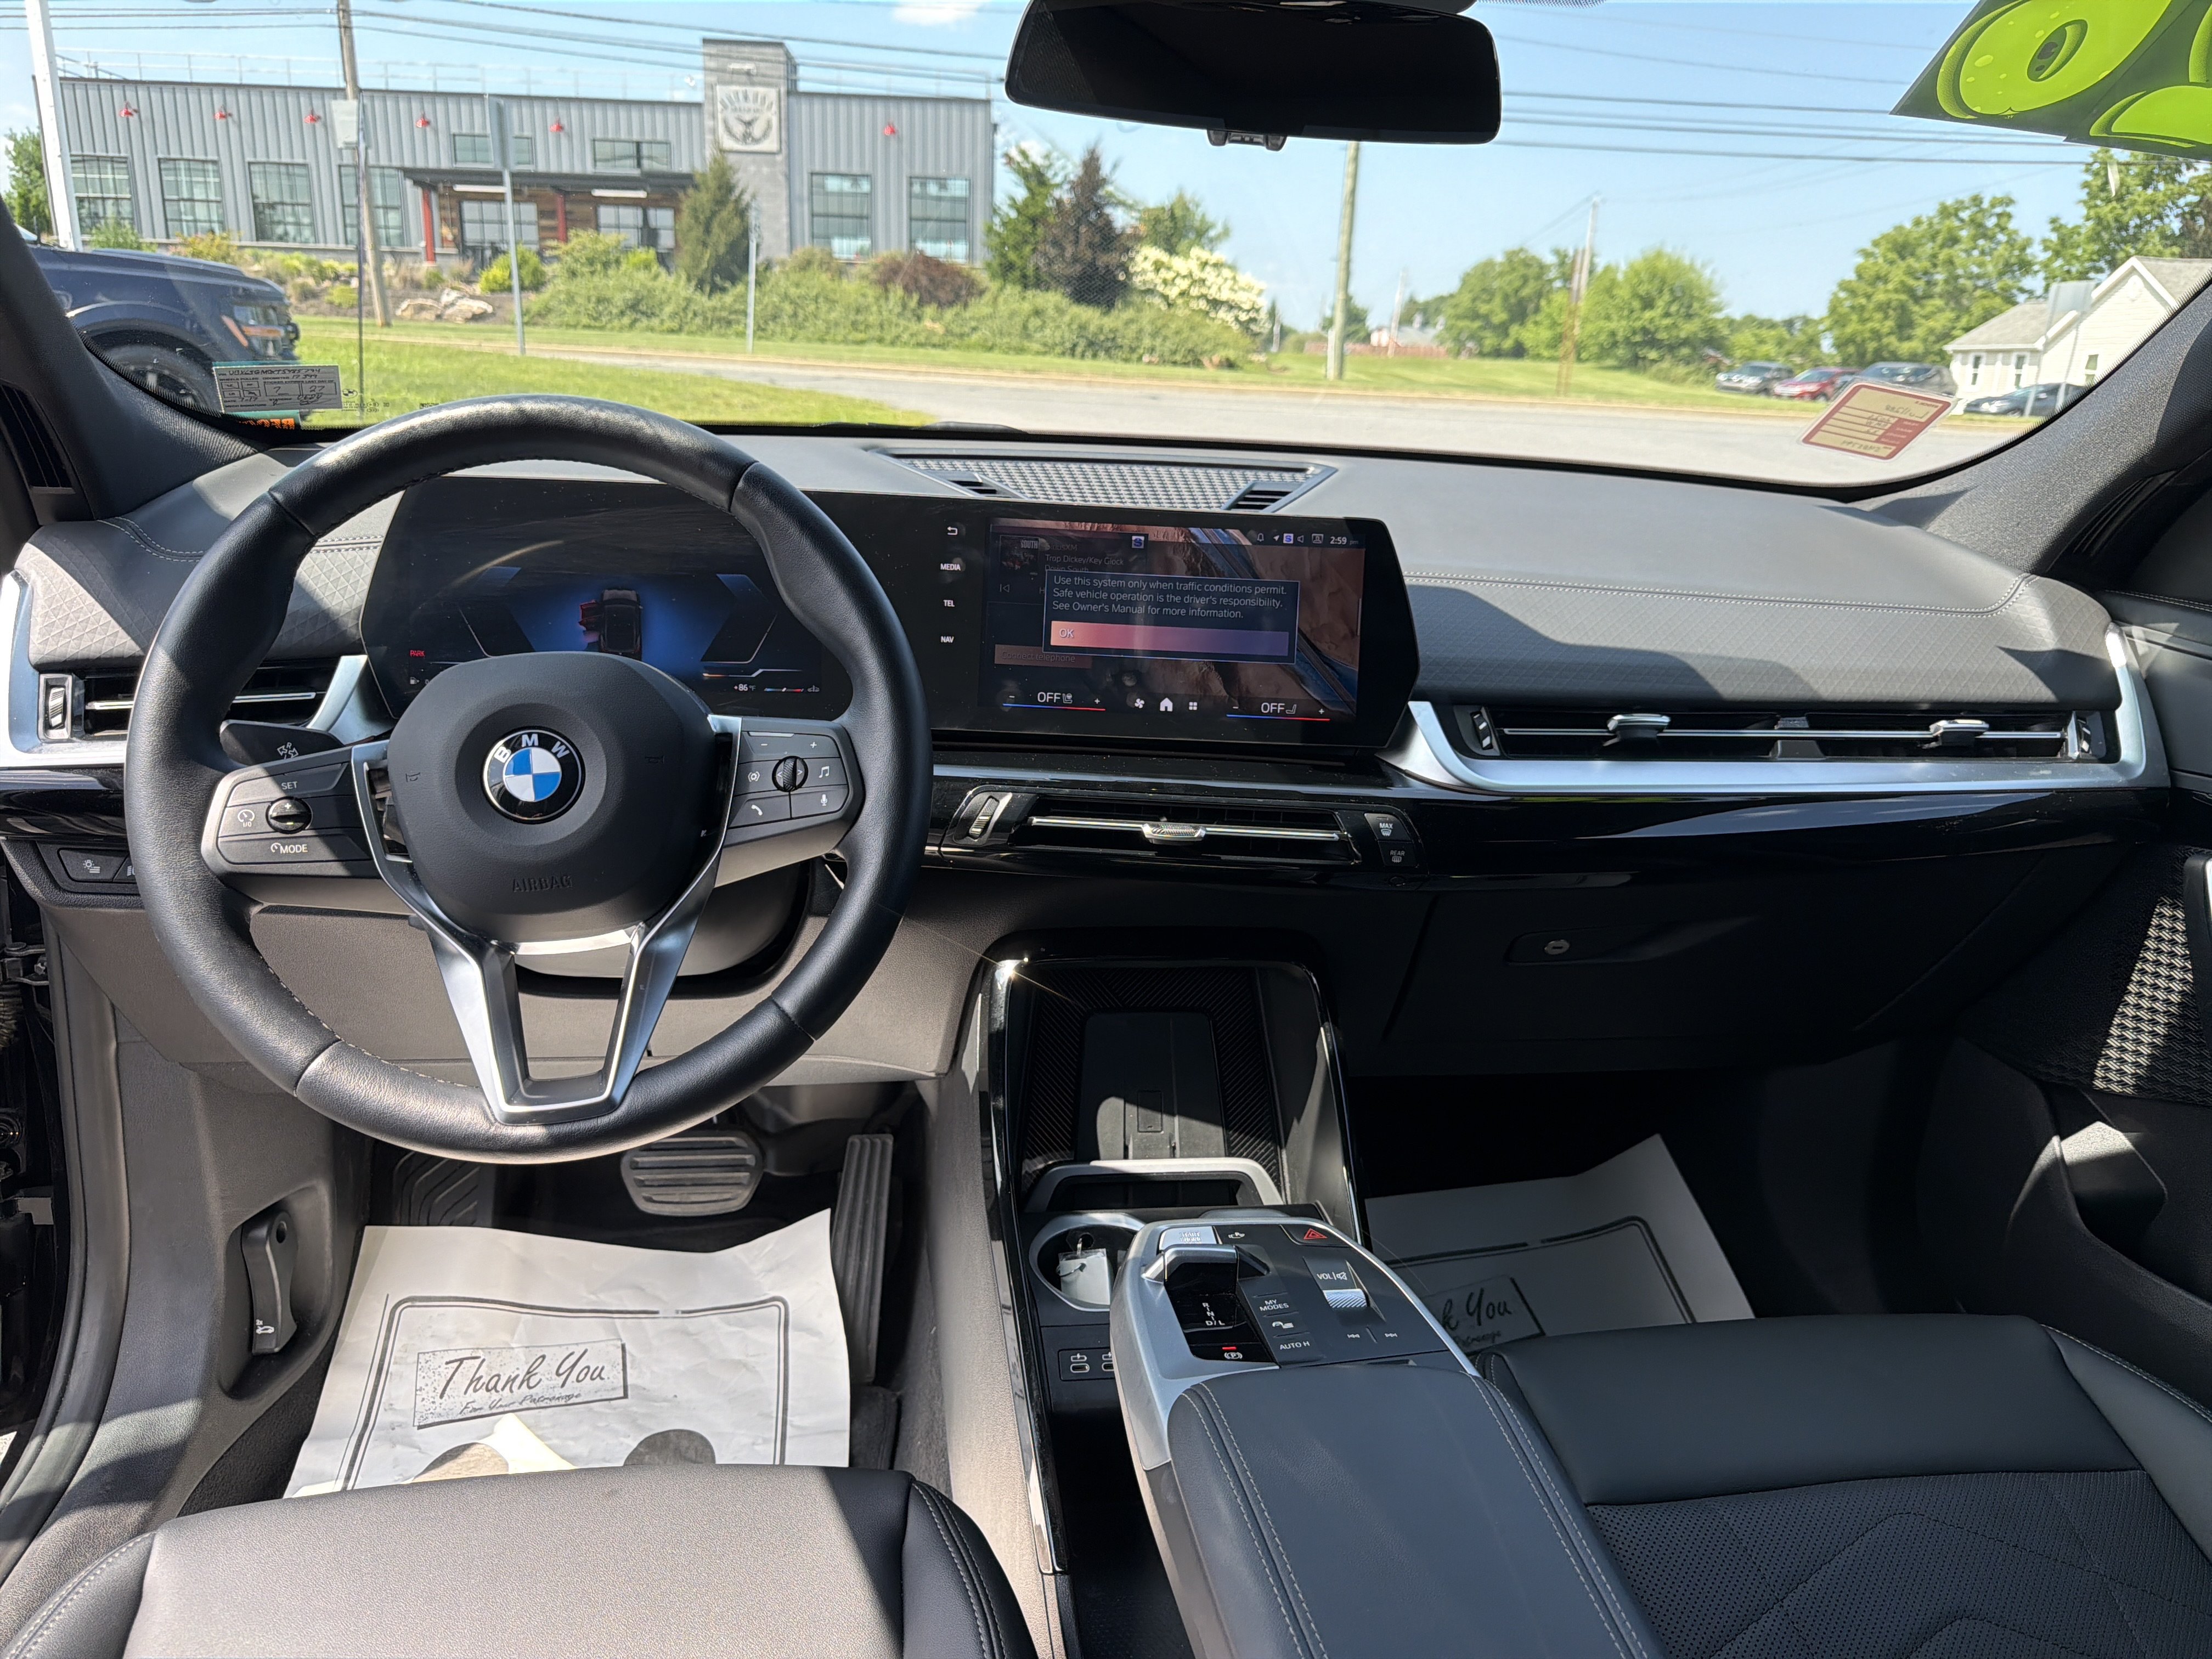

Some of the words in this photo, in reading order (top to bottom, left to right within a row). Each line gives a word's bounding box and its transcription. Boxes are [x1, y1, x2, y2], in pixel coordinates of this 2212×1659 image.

[1330, 536, 1347, 545] 2:59
[1054, 575, 1072, 585] Use
[1074, 576, 1091, 586] this
[1093, 579, 1125, 589] system
[1128, 579, 1148, 590] only
[1149, 580, 1173, 590] when
[1176, 582, 1202, 591] traffic
[1204, 583, 1252, 593] conditions
[1254, 585, 1286, 595] permit.
[1053, 588, 1074, 598] Safe
[1075, 590, 1108, 600] vehicle
[1110, 592, 1154, 602] operation
[1156, 592, 1164, 602] is
[1166, 594, 1182, 603] the
[1184, 595, 1217, 605] driver's
[1220, 597, 1283, 610] responsibility.
[1052, 600, 1070, 611] See
[1072, 601, 1109, 612] Owner's
[1111, 603, 1146, 614] Manual
[1148, 605, 1160, 615] for
[1162, 607, 1186, 617] more
[1189, 607, 1244, 619] information.
[1059, 628, 1074, 638] OK
[1001, 651, 1034, 660] Connect
[1035, 653, 1076, 663] telephone
[1037, 691, 1062, 703] OFF
[1260, 702, 1286, 714] OFF
[494, 733, 571, 763] BMW
[280, 780, 298, 791] SET
[279, 843, 308, 855] MODE
[511, 873, 574, 894] AIRBAG
[1259, 1302, 1290, 1312] MODES
[1465, 1287, 1513, 1327] You
[1279, 1342, 1302, 1351] AUTO
[439, 1354, 548, 1400] Thank
[555, 1348, 606, 1389] You
